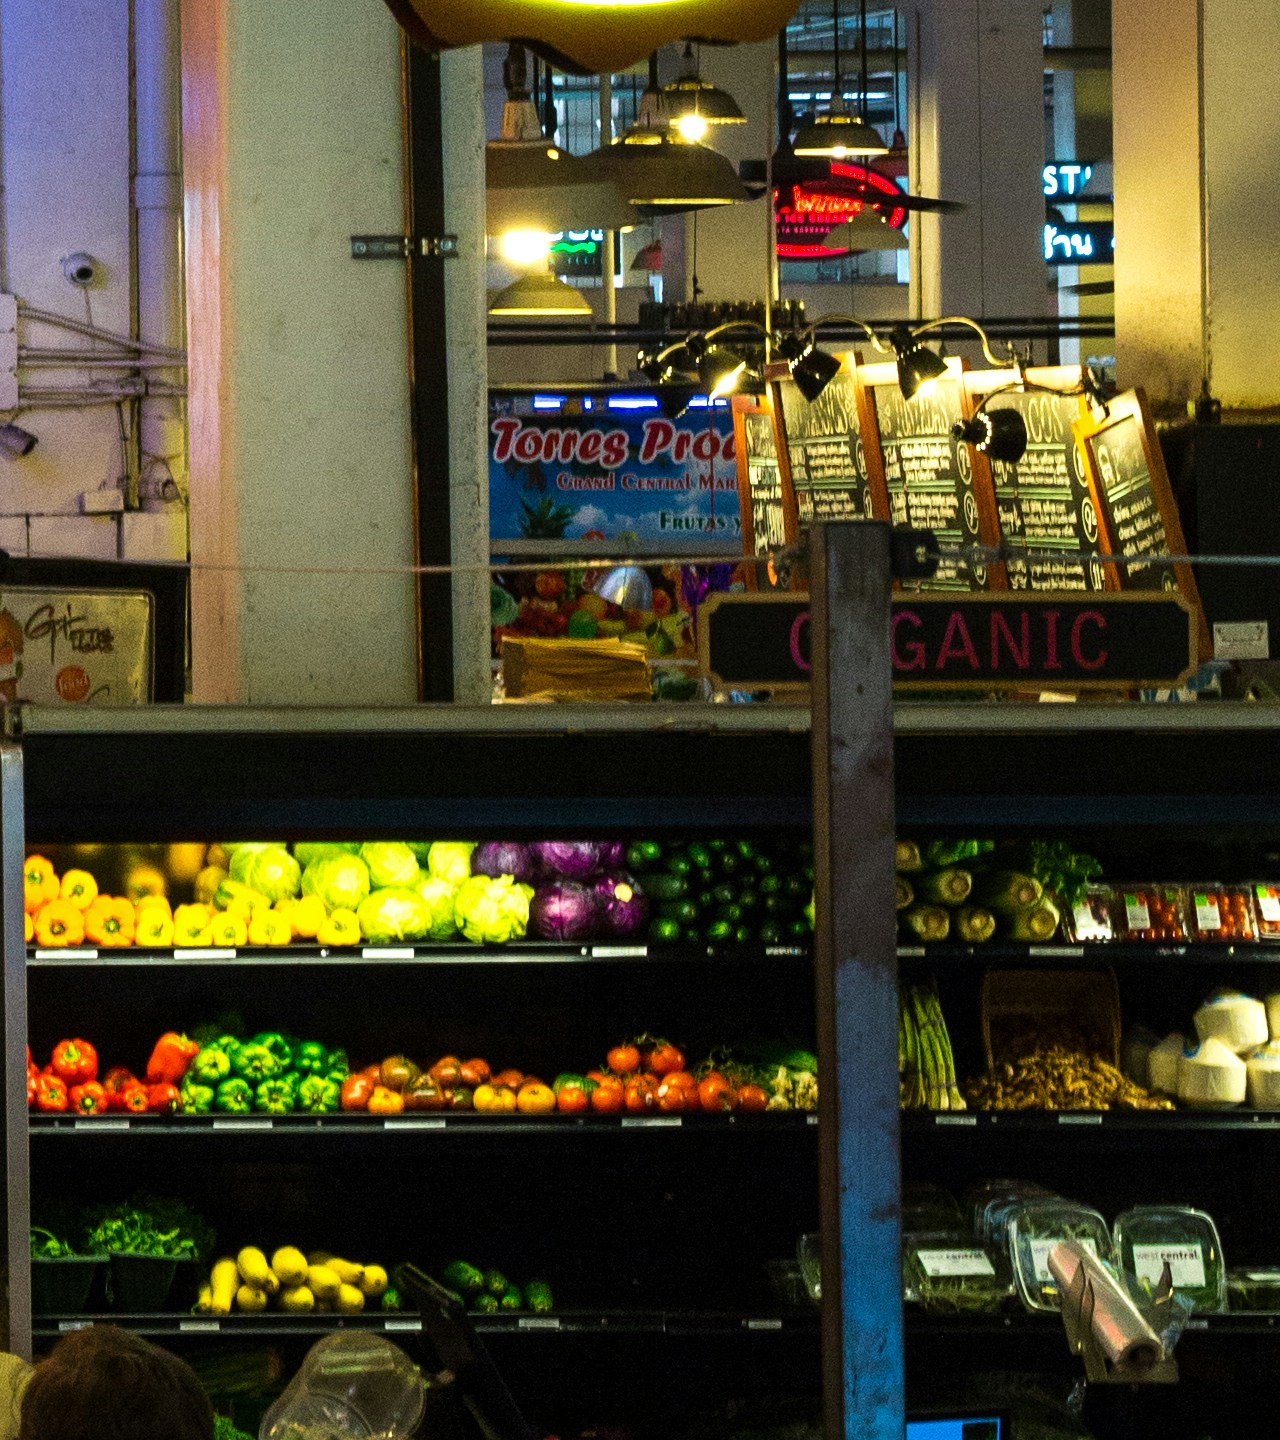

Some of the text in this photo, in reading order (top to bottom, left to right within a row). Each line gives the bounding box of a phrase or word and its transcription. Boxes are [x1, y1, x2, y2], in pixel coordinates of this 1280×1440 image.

[491, 417, 630, 469] Torres
[788, 610, 1109, 670] OGANIC
[1160, 1250, 1198, 1261] central
